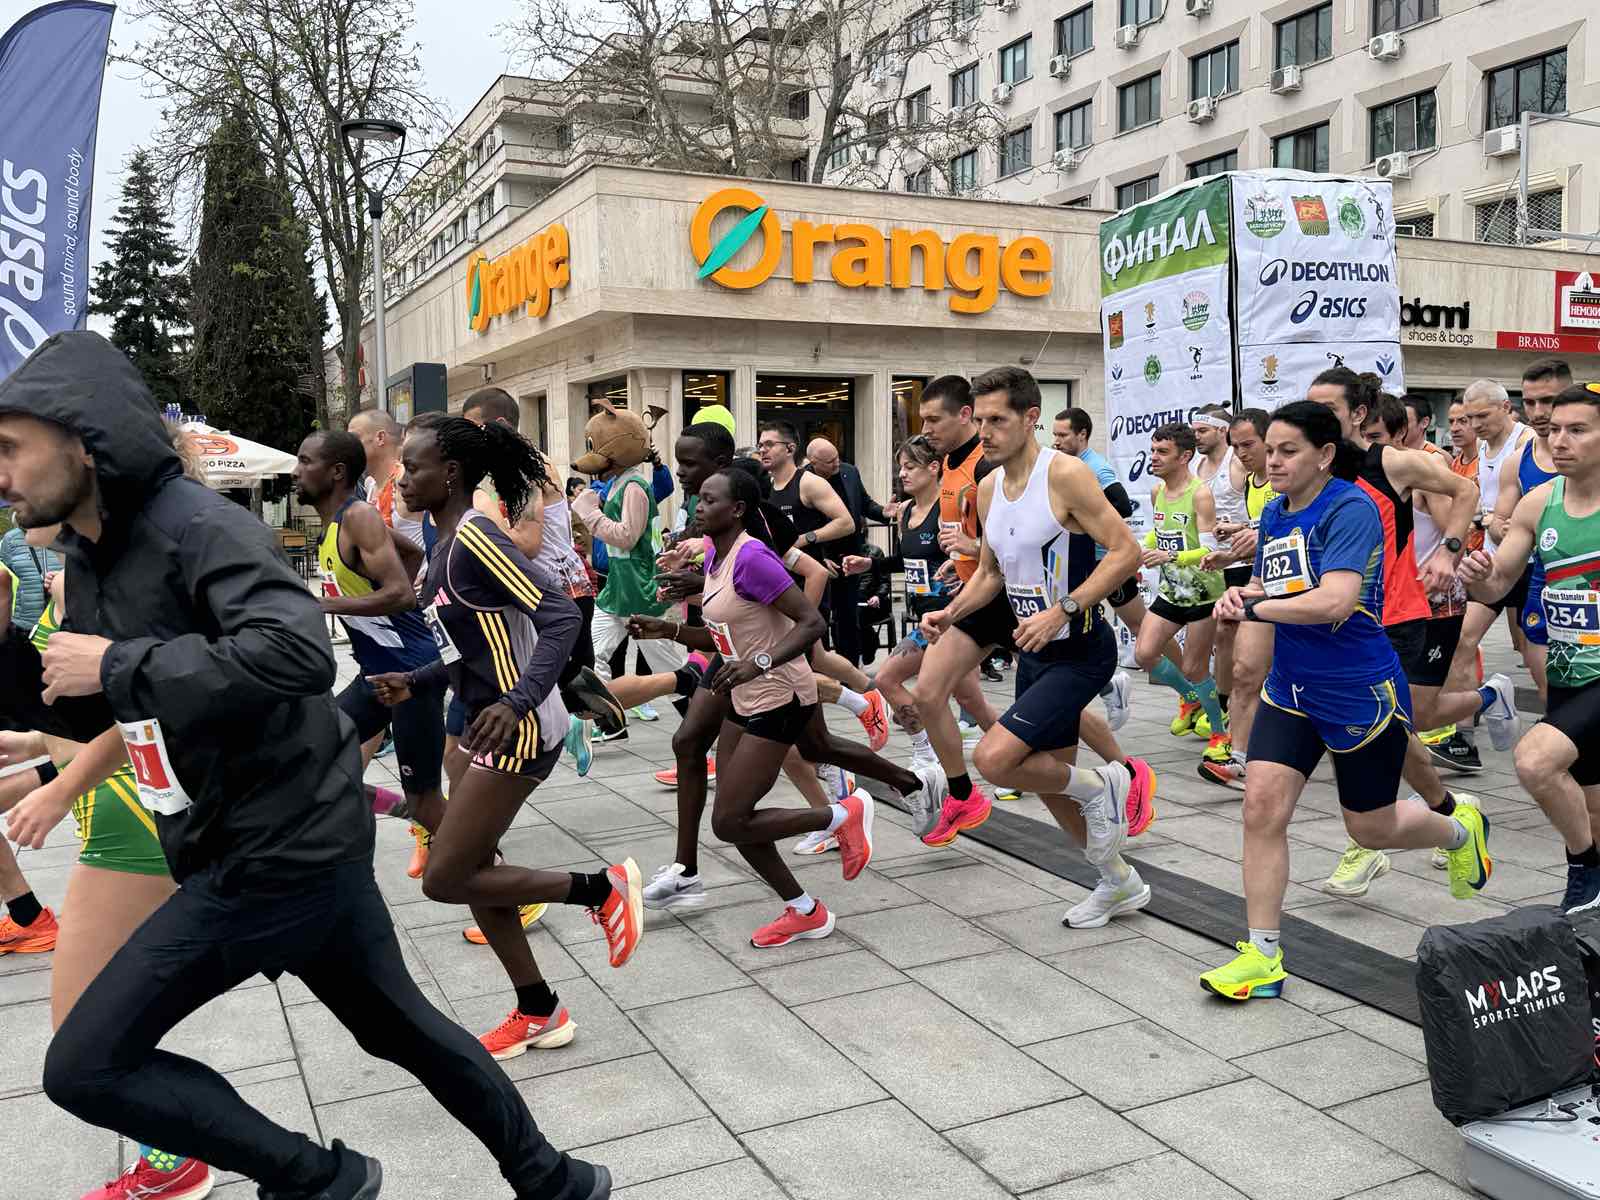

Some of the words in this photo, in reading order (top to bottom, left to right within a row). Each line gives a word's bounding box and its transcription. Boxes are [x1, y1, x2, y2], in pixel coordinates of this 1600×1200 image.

[65, 147, 84, 187] body
[64, 185, 80, 231] sound
[0, 159, 48, 302] asics
[62, 234, 78, 272] mind,
[690, 188, 1053, 314] Orange
[1103, 208, 1217, 281] ФИНАЛ
[466, 223, 571, 332] Orange
[1291, 261, 1390, 282] DECATHLON
[60, 271, 76, 316] sound
[1319, 297, 1368, 319] asics
[1408, 328, 1438, 343] shoes
[1439, 330, 1447, 343] &
[1448, 331, 1474, 346] bags
[1518, 336, 1560, 349] BRANDS
[1126, 407, 1201, 436] DECATHLO
[217, 460, 246, 469] PIZZA
[1158, 538, 1179, 551] 206
[1265, 555, 1293, 580] 282
[1012, 598, 1035, 617] 249
[1547, 605, 1589, 628] 254
[1464, 965, 1562, 1016] MYLAPS
[1523, 991, 1566, 1015] TIMING
